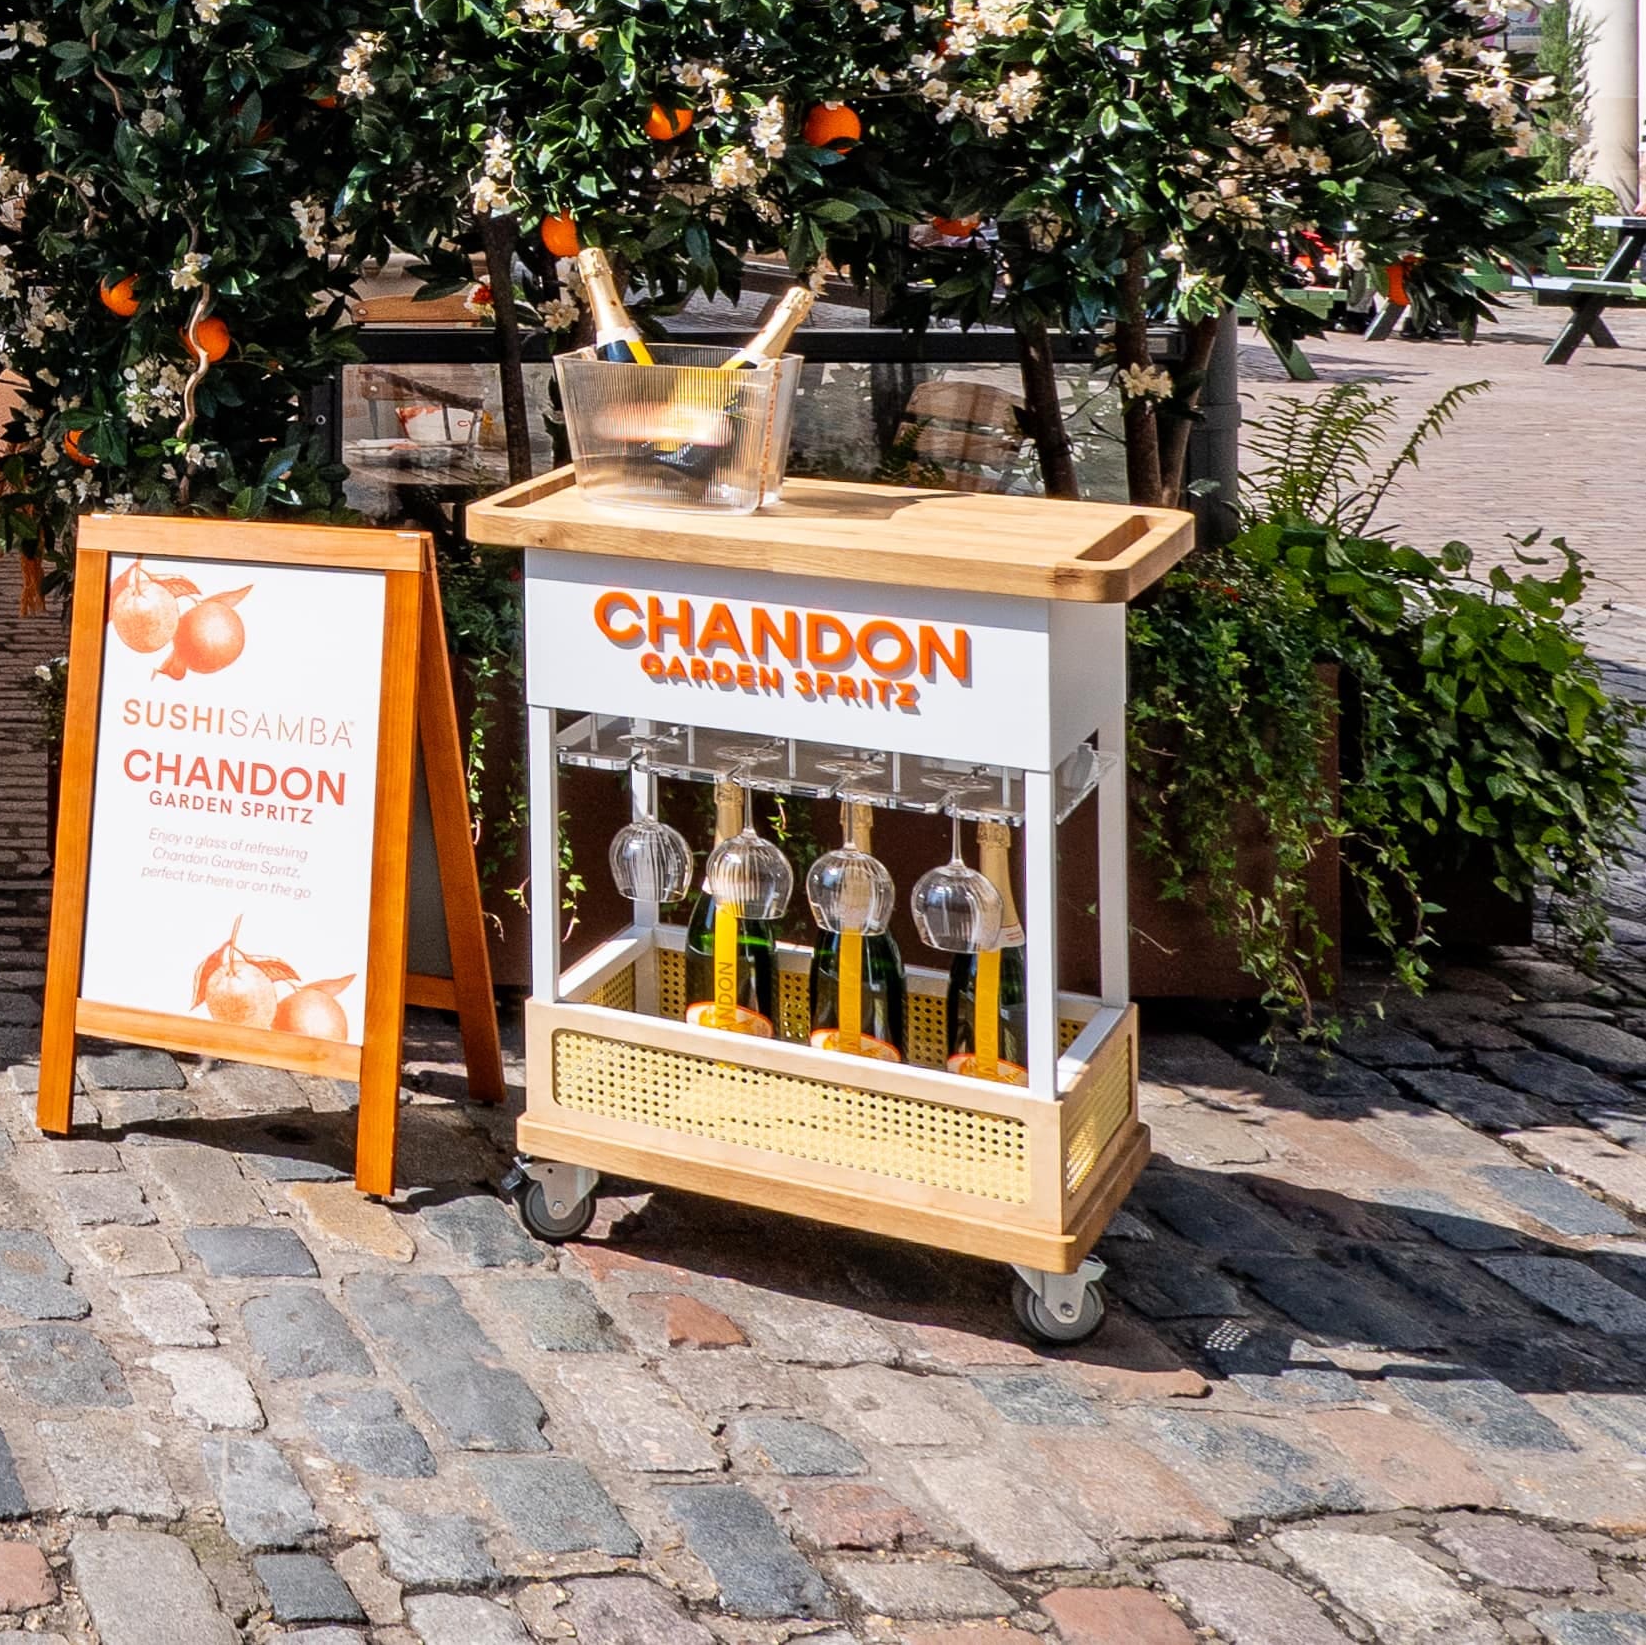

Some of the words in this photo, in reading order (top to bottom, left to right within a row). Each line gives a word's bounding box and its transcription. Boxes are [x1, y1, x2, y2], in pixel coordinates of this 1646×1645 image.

[593, 591, 970, 681] CHANDON
[640, 652, 782, 691] GARDEN
[794, 671, 918, 708] SPRITZ
[123, 698, 353, 749] SUSHISAMBA
[123, 748, 347, 806] CHANDON
[149, 790, 232, 815] GARDEN
[241, 801, 313, 824] SPRITZ
[149, 827, 182, 846] Enjoy
[184, 834, 193, 845] a
[195, 834, 227, 850] glass
[230, 838, 243, 851] of
[245, 842, 308, 863] refreshing
[152, 846, 208, 866] Chandon
[211, 854, 258, 873] Garden
[141, 865, 185, 882] perfect
[187, 870, 204, 884] for
[206, 873, 233, 889] here
[236, 879, 249, 890] or
[251, 881, 268, 893] on
[270, 882, 292, 897] the
[294, 887, 311, 901] go
